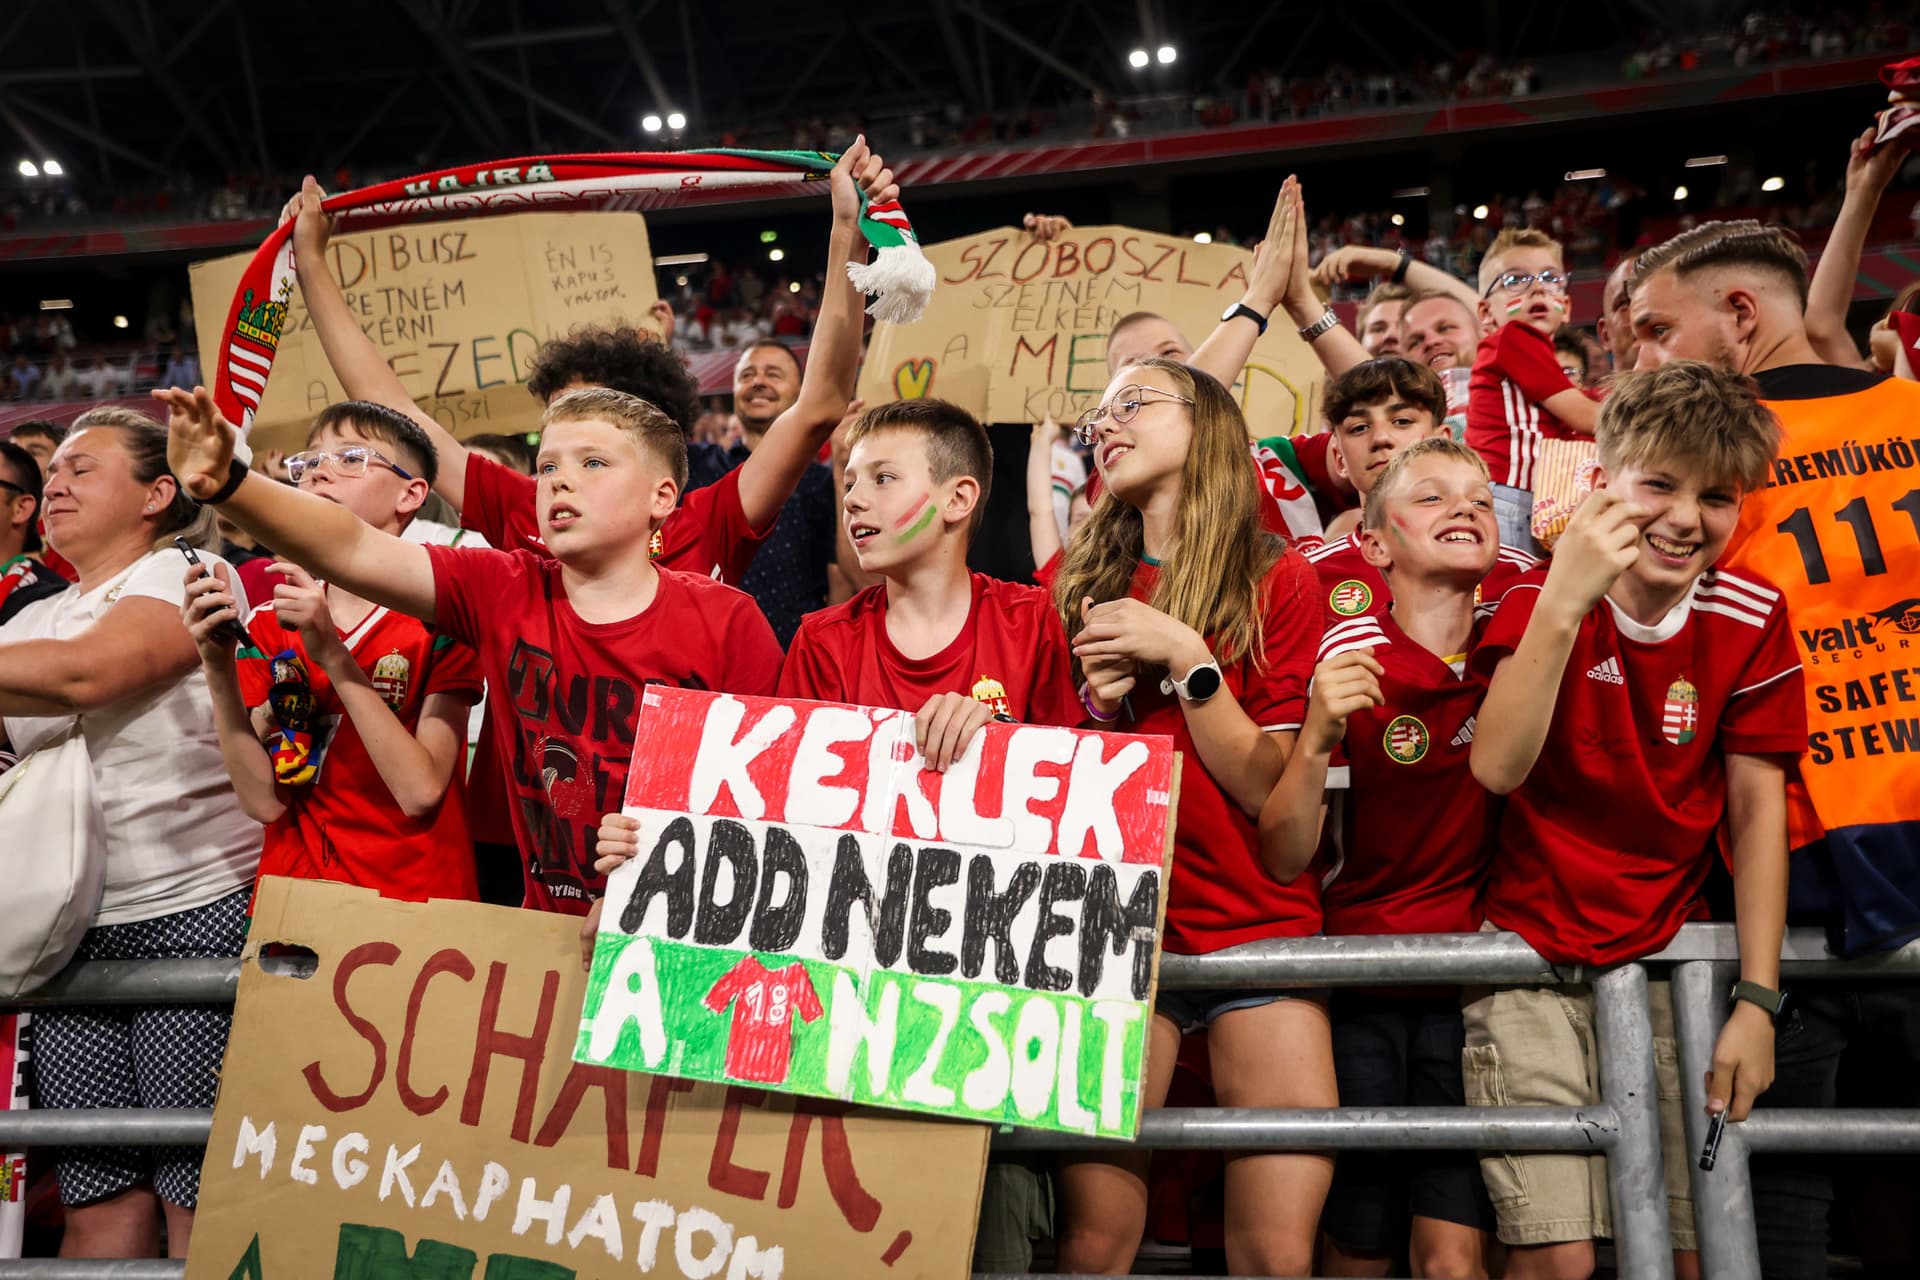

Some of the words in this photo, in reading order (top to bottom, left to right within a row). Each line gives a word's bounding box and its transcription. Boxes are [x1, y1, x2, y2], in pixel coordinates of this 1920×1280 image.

[327, 232, 477, 290] DIBUSZ
[545, 240, 577, 273] ÉN
[589, 243, 613, 265] IS
[552, 266, 615, 293] KAPUS
[433, 394, 491, 433] ÖSZI
[1766, 436, 1920, 489] REMŰKÖ
[1586, 668, 1625, 686] adidas
[619, 816, 808, 953] ADD
[821, 833, 1160, 1001] NEKEM
[589, 936, 668, 1068] A
[745, 980, 788, 1025] 18
[232, 1114, 785, 1280] MEGKAPHATOM
